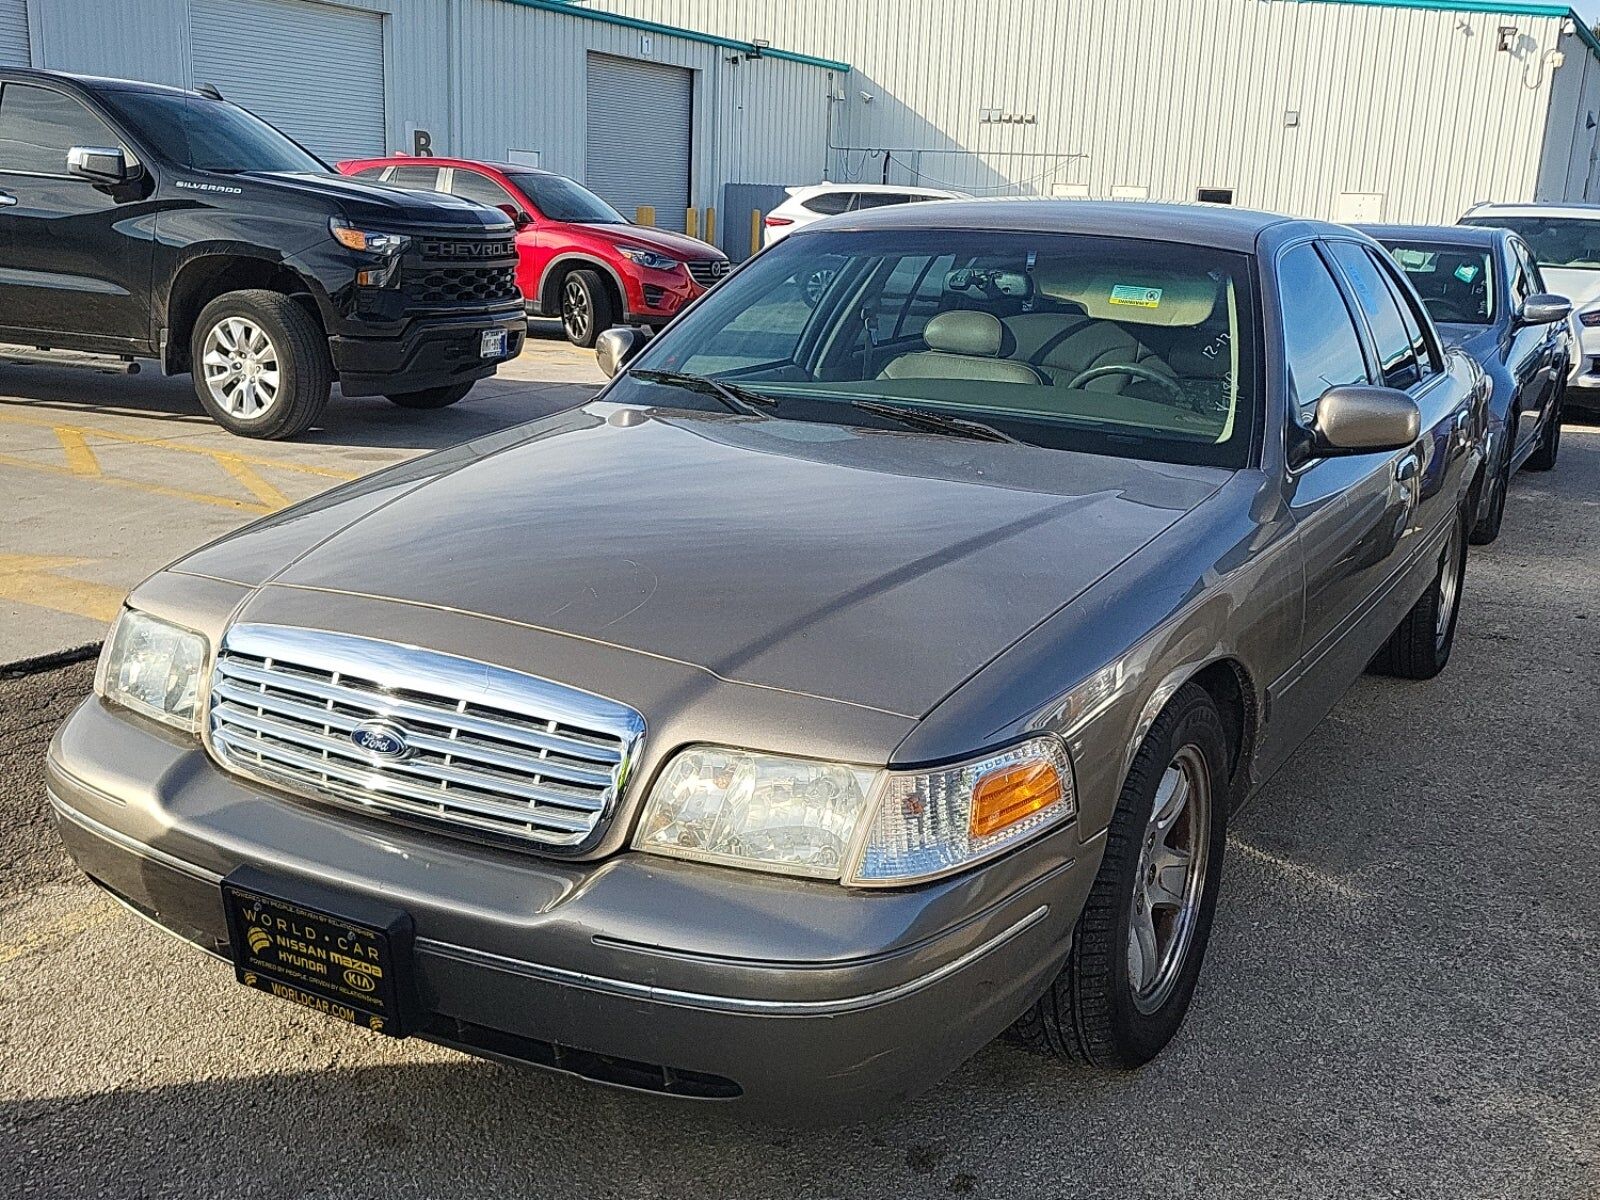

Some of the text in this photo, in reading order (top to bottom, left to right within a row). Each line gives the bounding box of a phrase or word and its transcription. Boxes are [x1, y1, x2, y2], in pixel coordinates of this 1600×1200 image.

[414, 130, 433, 157] B
[176, 181, 242, 194] SILVERADO
[420, 242, 516, 255] CHEVROLE
[361, 732, 390, 751] Ford
[242, 907, 379, 960] WORLD CAR
[276, 934, 382, 977] NISSAN mazda
[278, 950, 327, 975] HYUNDAI
[347, 972, 370, 988] KIA
[271, 982, 355, 1022] WORLDCAR.COM
